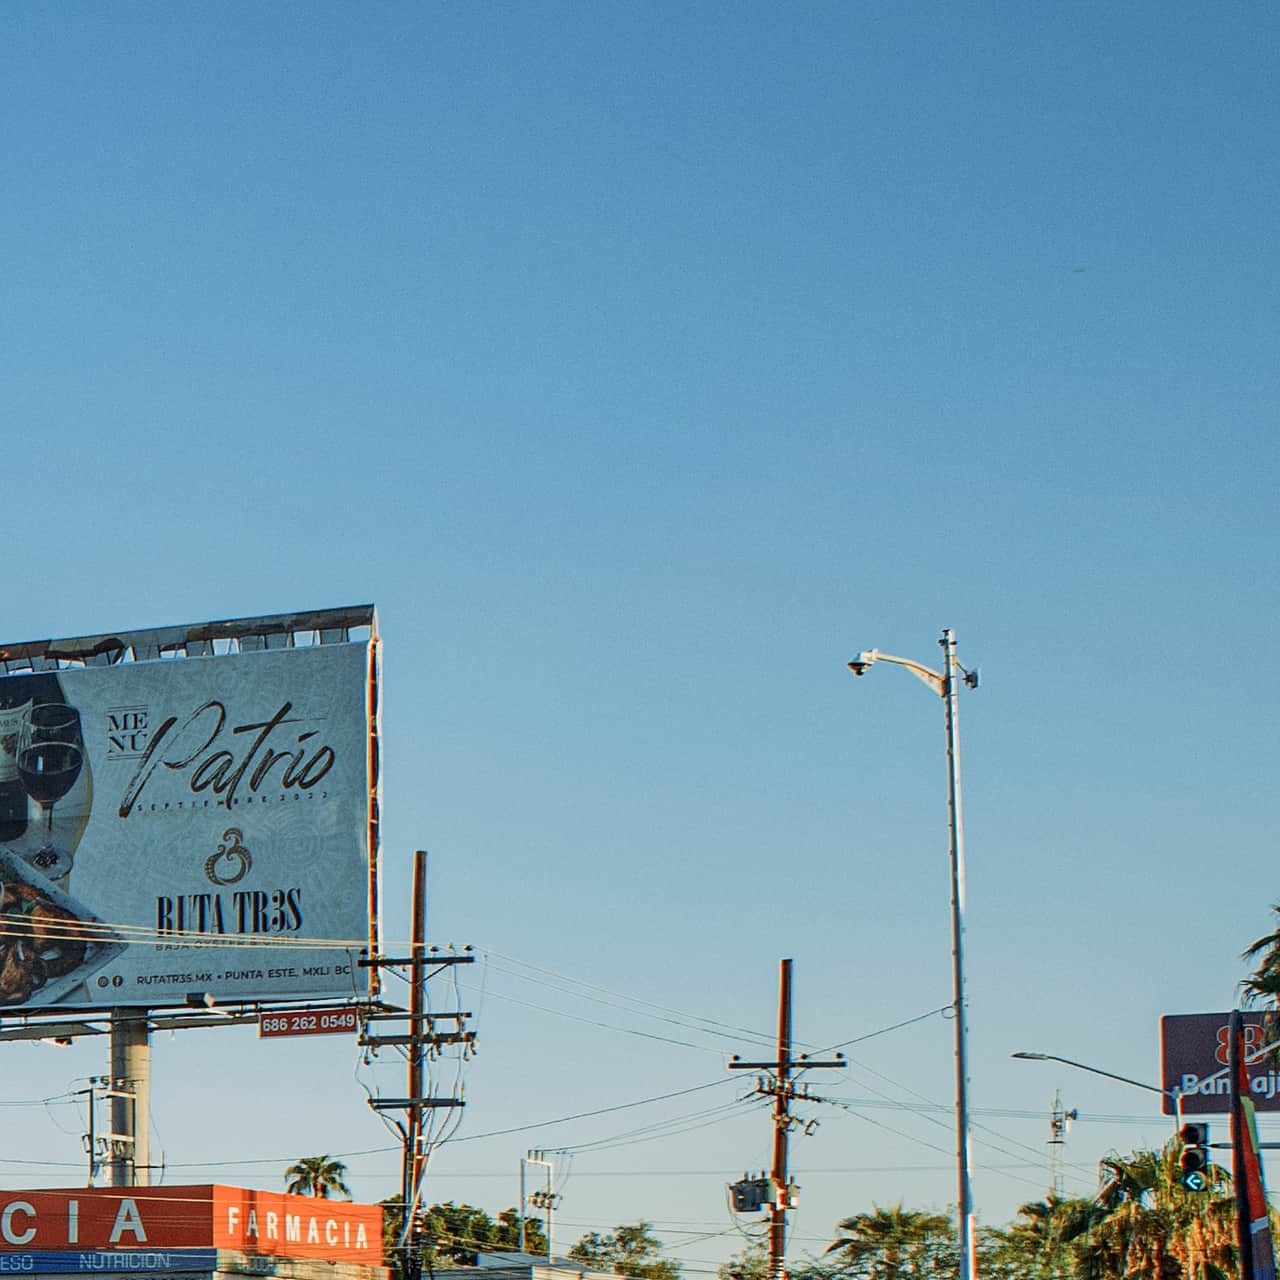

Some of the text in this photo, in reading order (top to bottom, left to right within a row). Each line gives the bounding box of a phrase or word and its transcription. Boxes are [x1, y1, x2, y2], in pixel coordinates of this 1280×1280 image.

[107, 712, 148, 731] ME
[157, 888, 302, 937] RUTA TR3S
[225, 970, 263, 980] PUNTA
[335, 965, 351, 975] BC
[263, 1014, 355, 1031] 686 262 0549
[1181, 1071, 1280, 1099] Banaj
[228, 1207, 368, 1249] FARMACIA
